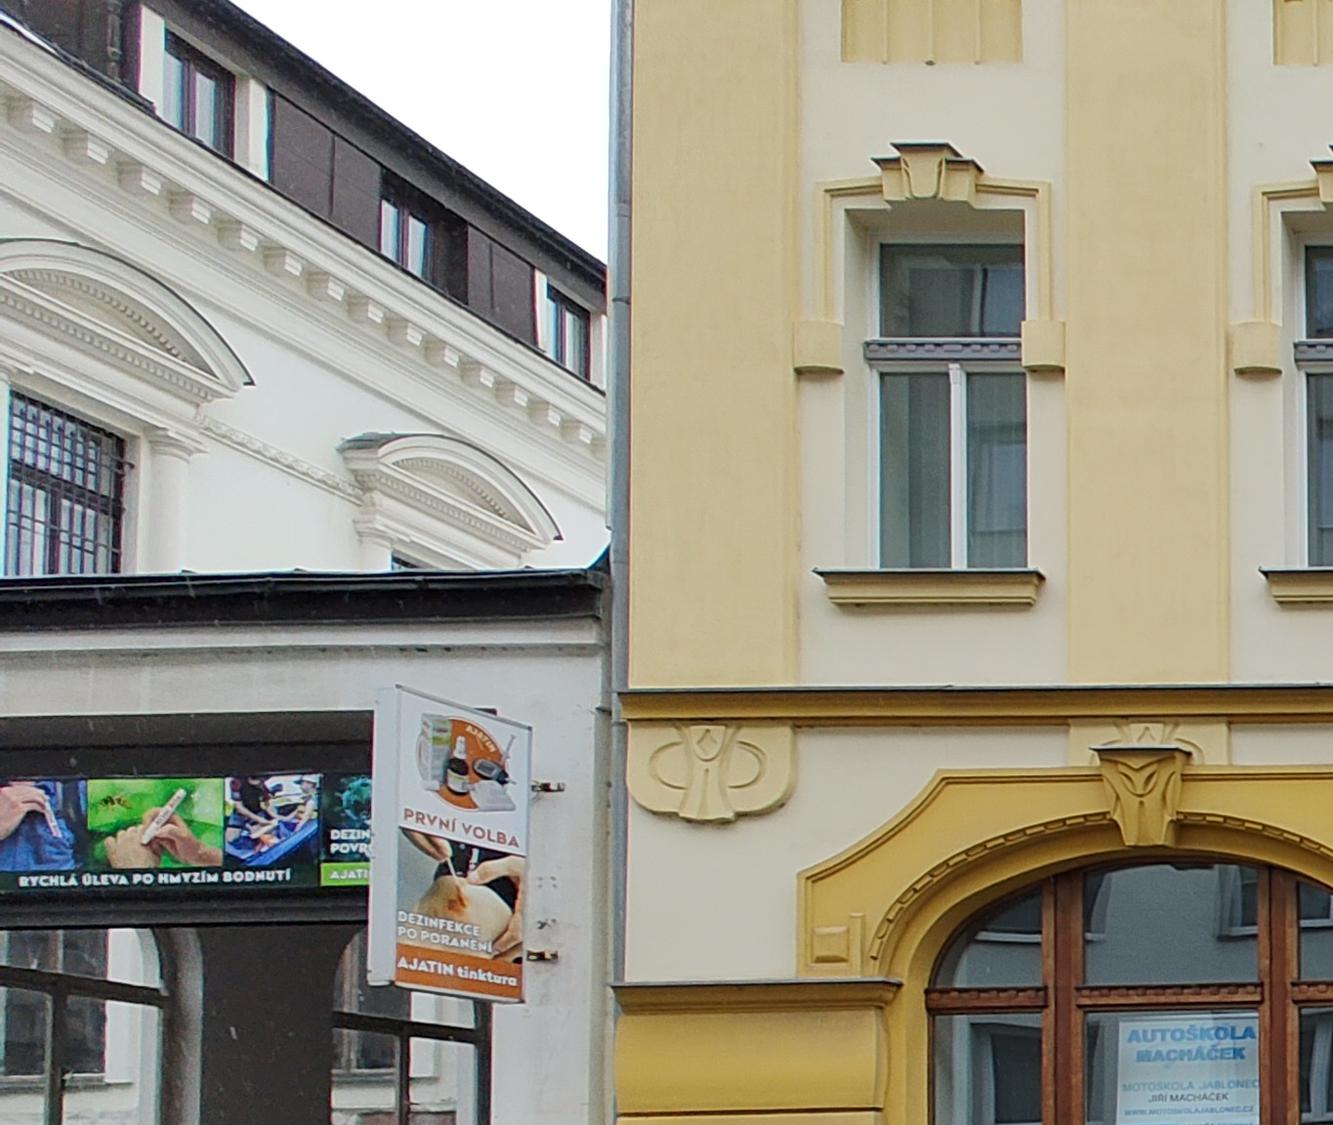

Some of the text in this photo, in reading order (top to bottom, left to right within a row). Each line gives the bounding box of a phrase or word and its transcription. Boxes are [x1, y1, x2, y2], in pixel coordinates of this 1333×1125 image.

[404, 808, 519, 848] PRVNÍ VOLBA
[19, 868, 291, 887] RYCHLÁ ÚLEVA PO HMYZÍM BODNUTÍ
[397, 911, 480, 936] DEZINFEKCE
[397, 926, 417, 939] PO
[397, 957, 518, 987] AJATIN tinktura
[1127, 1024, 1256, 1043] AUTOŠKOLA
[1136, 1043, 1246, 1062] MACHÁČEK
[1200, 1079, 1260, 1091] JABLONEC
